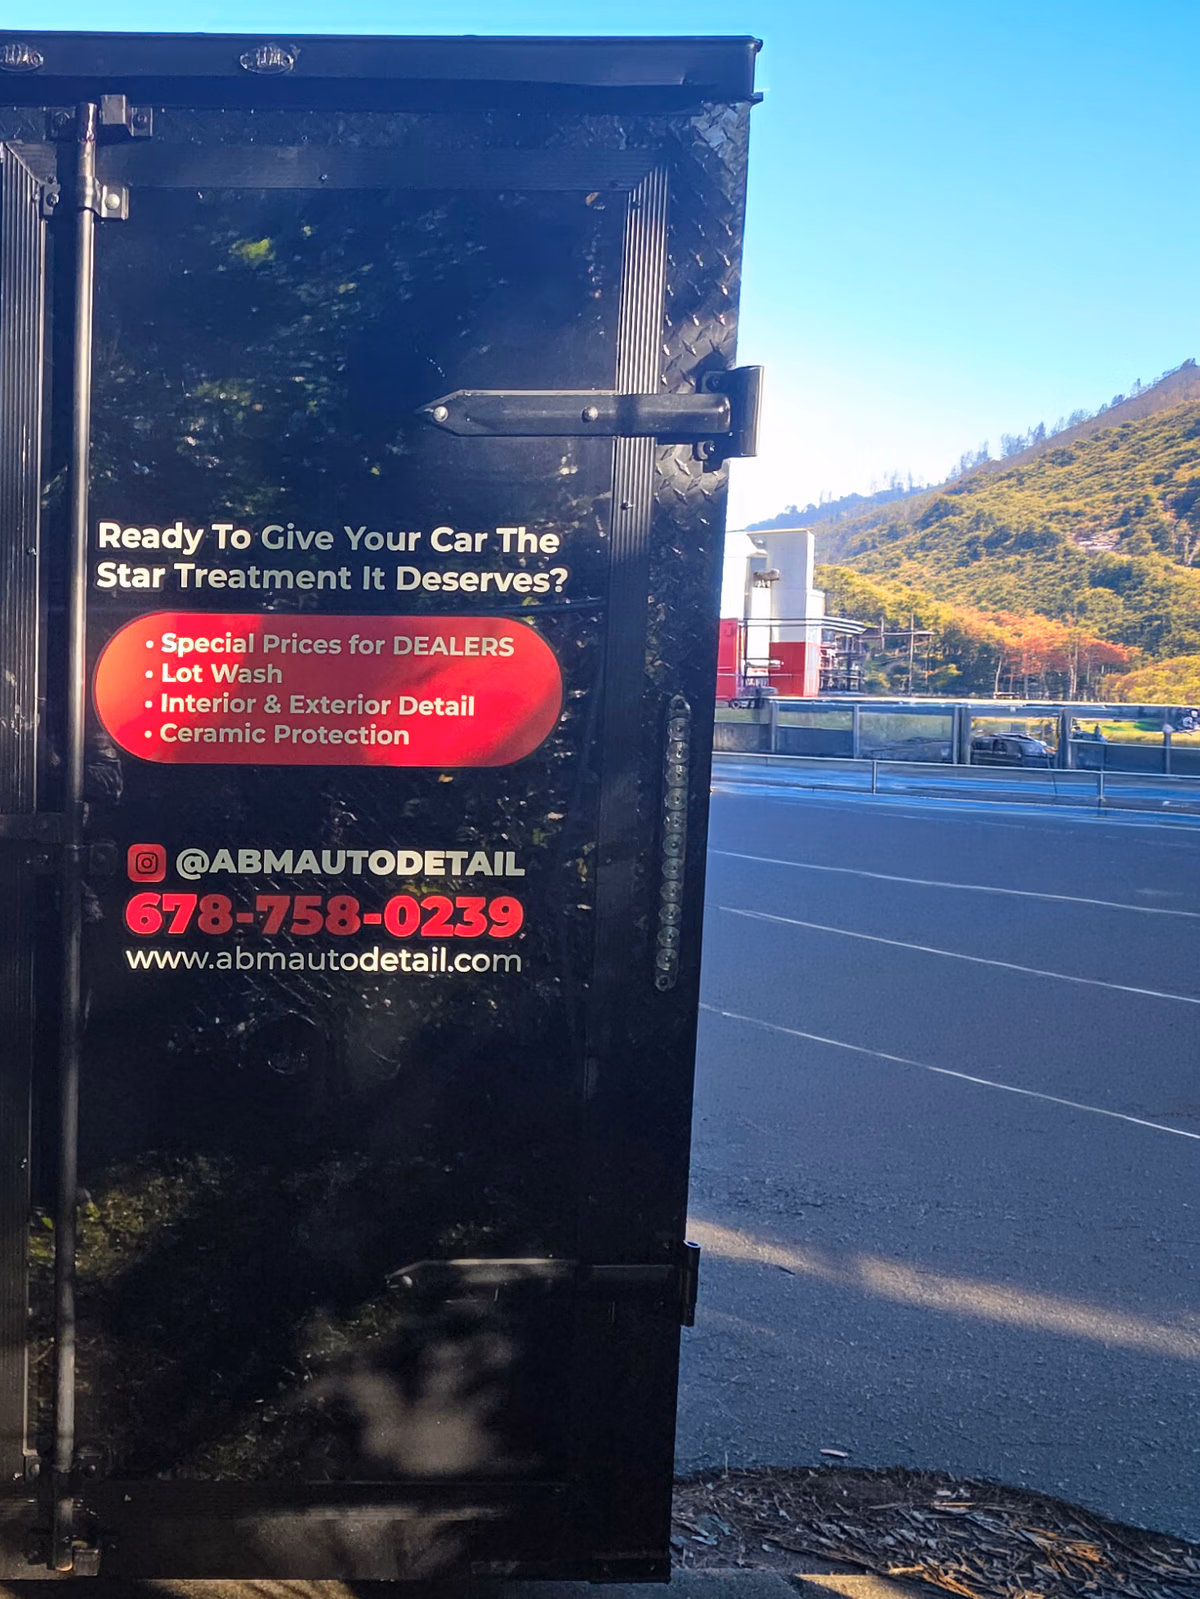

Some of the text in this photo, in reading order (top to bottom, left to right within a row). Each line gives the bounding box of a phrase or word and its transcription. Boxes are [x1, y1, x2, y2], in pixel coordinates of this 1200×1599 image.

[98, 523, 560, 555] Ready To Give Your Car The
[97, 563, 567, 593] Star Treatment It Deserves?
[161, 633, 514, 657] Special Prices for DEALERS
[161, 663, 282, 684] Lot Wash
[161, 693, 475, 716] Interior & Exterior Detail
[160, 724, 409, 745] Ceramic Protection
[176, 848, 525, 879] @ABMAUTODETAIL
[125, 893, 524, 938] 678-758-0239
[125, 946, 522, 973] www.abmautodetail.com
